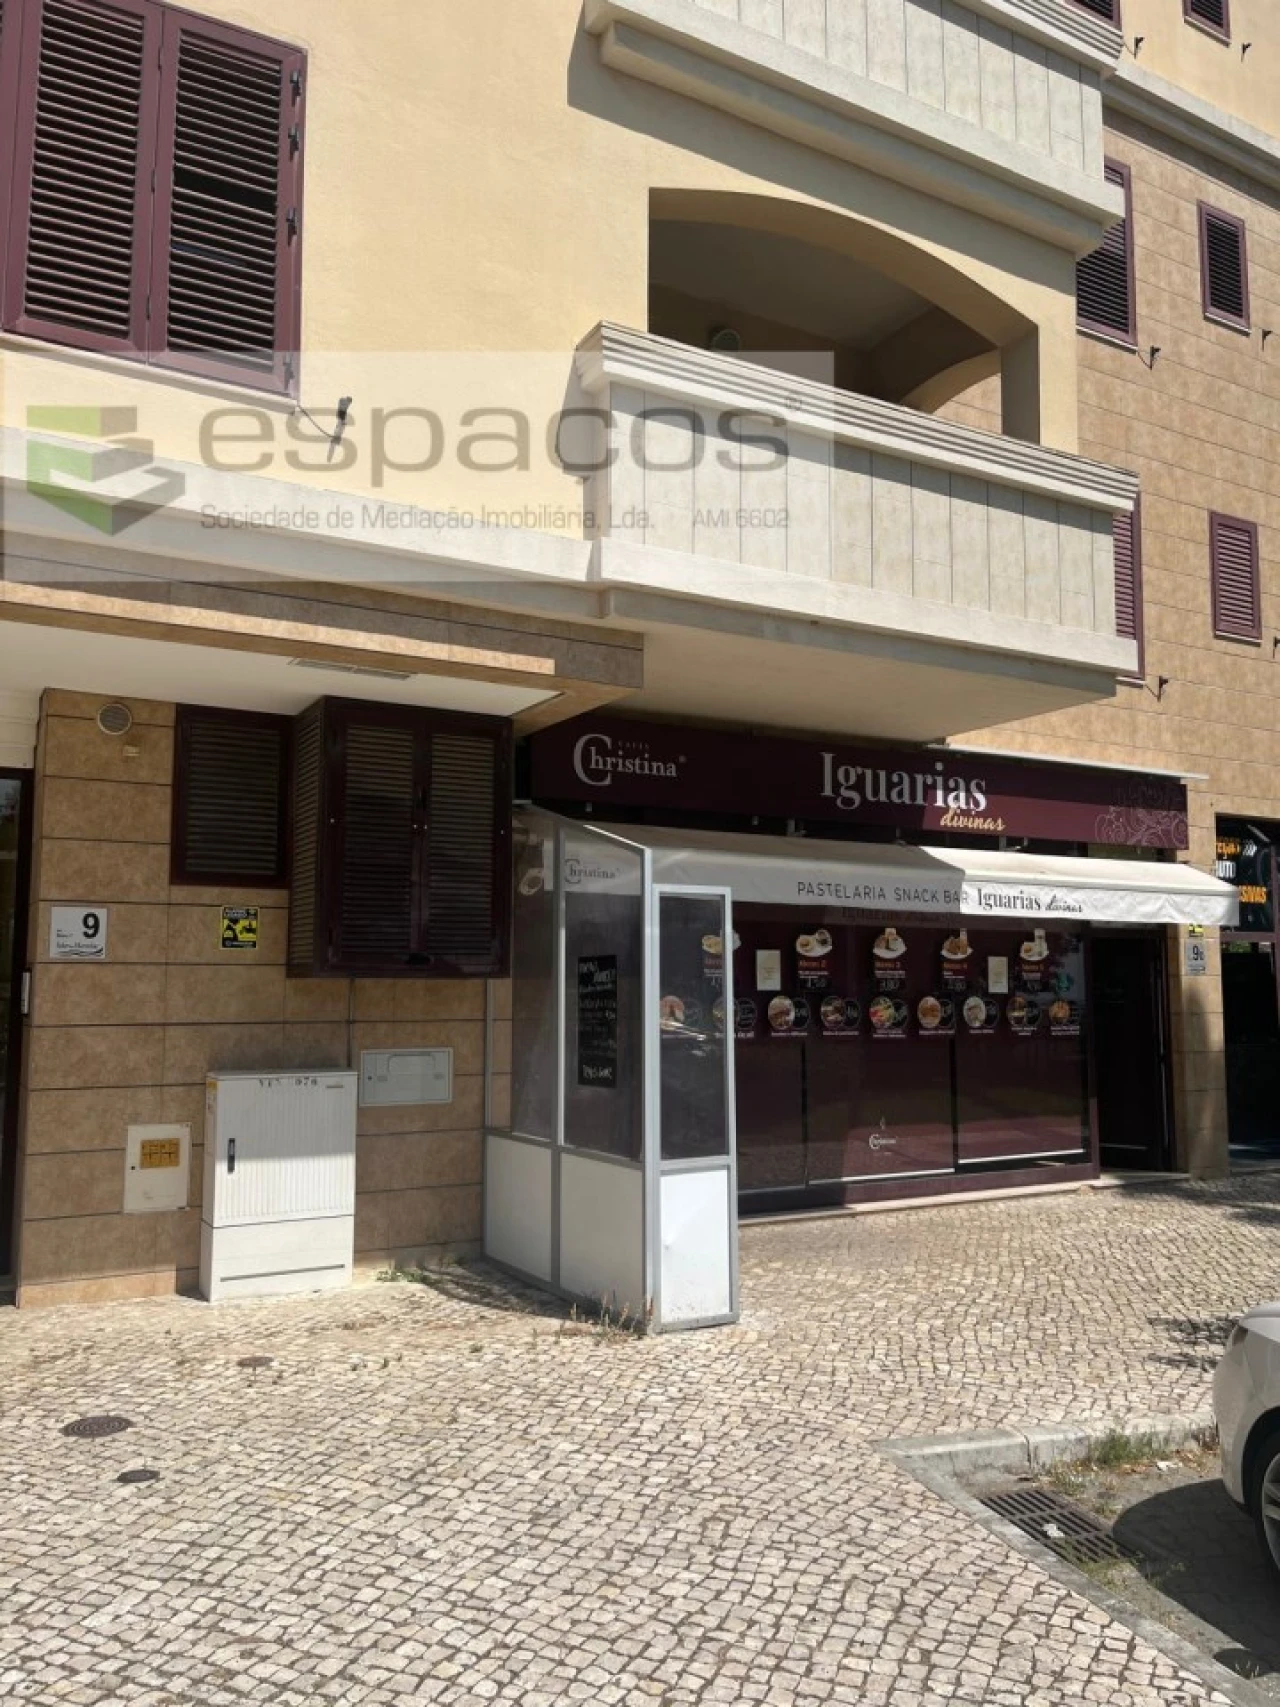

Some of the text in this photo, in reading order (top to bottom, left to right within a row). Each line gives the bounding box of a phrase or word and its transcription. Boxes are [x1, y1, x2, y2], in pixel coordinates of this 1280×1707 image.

[573, 733, 677, 787] Christina
[819, 751, 988, 811] Iguarias
[939, 807, 1007, 832] divinas
[797, 881, 887, 901] PASTELARIA
[893, 886, 940, 904] SNACK
[943, 890, 970, 906] BAR
[977, 888, 1041, 911] Iguarias
[83, 911, 101, 939] 9
